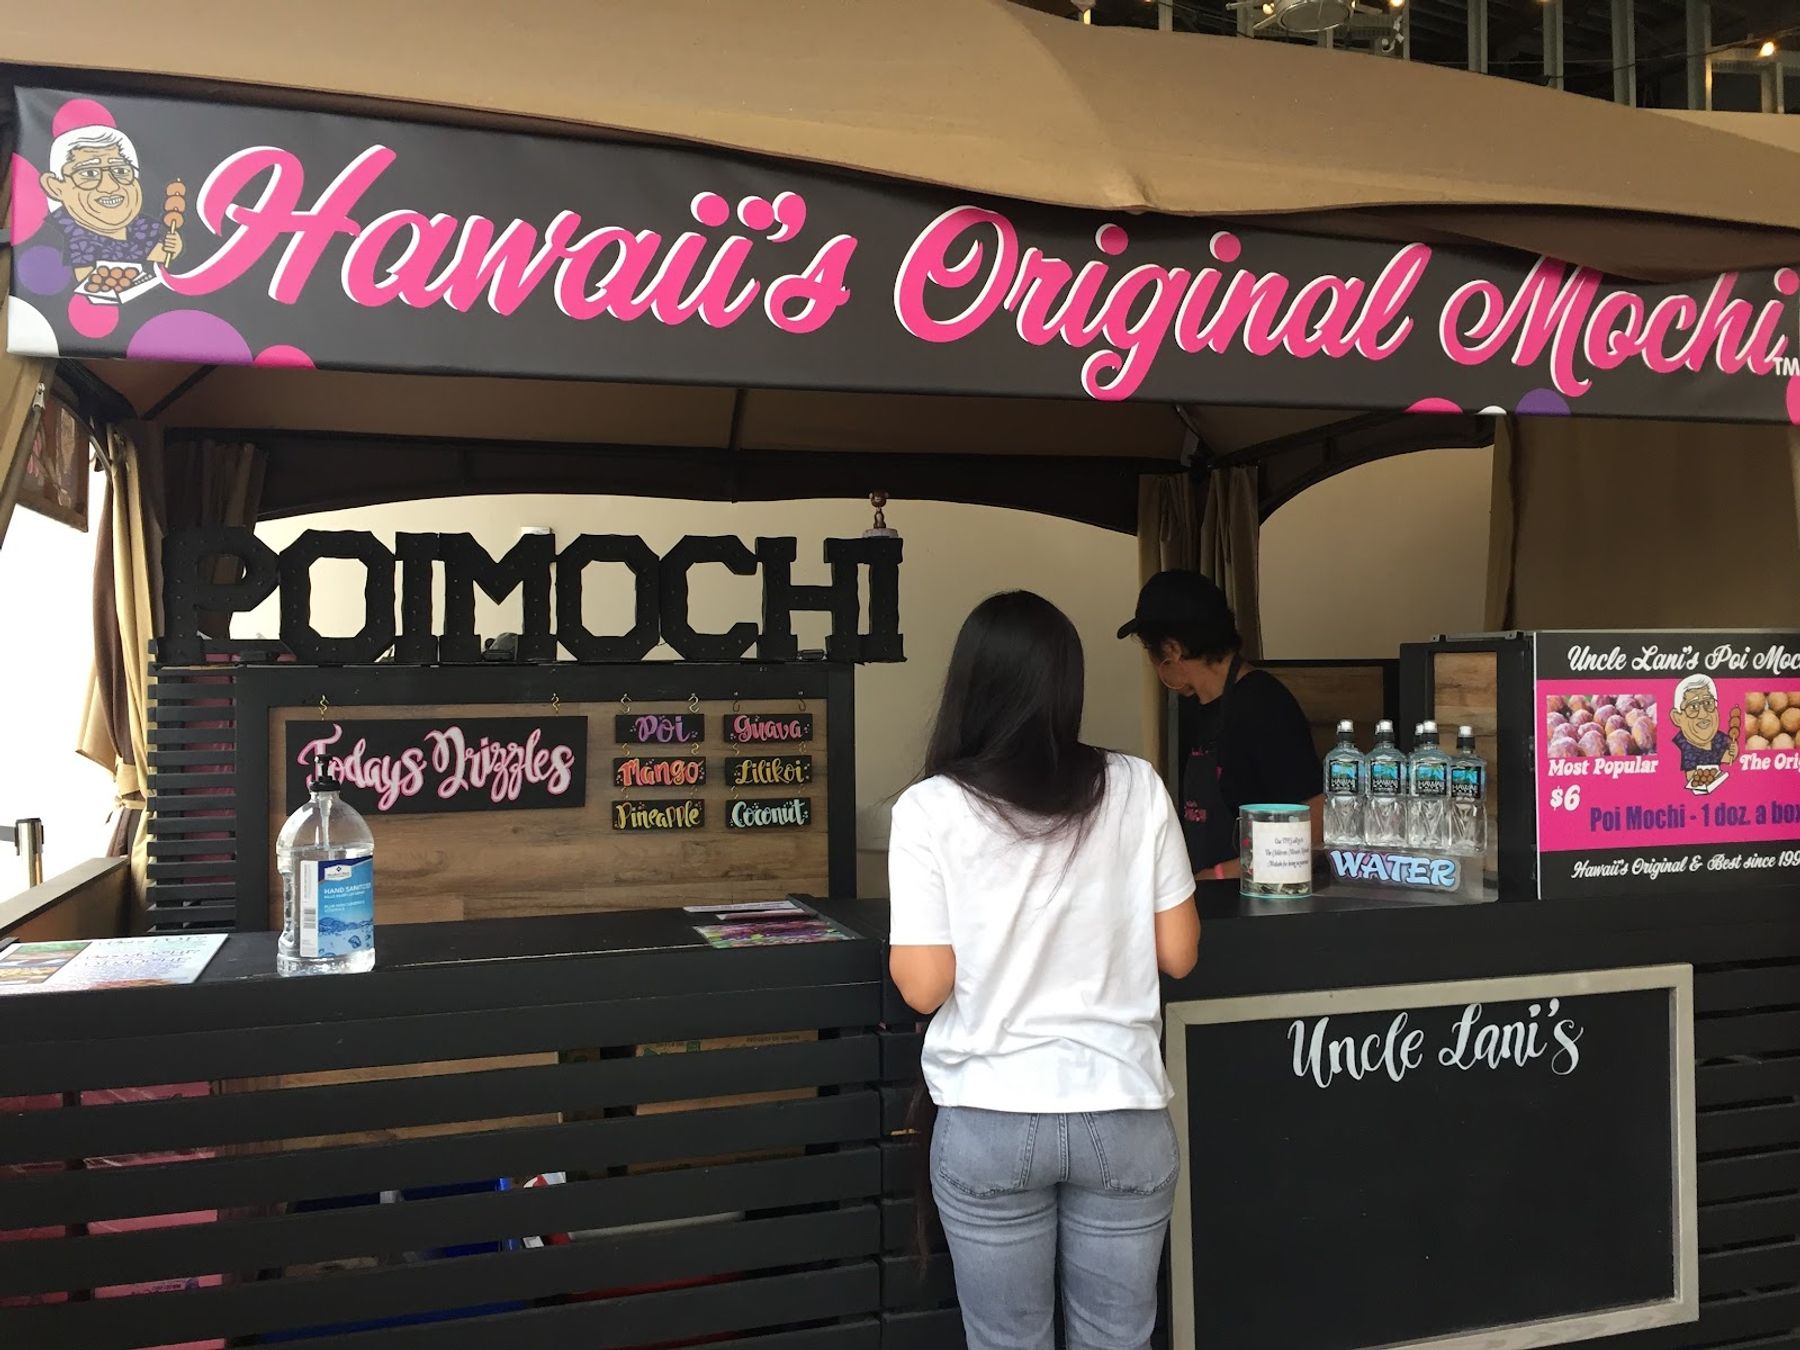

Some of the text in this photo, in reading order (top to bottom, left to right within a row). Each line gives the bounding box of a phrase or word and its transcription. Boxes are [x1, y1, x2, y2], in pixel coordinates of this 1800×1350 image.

[160, 144, 858, 334] Hawaii's
[894, 204, 1432, 402] Original
[1438, 254, 1800, 398] Mochi
[1567, 645, 1627, 671] Uncle
[1632, 645, 1699, 671] Lani's
[1704, 644, 1751, 670] Poi
[634, 715, 690, 743] Poi
[733, 715, 801, 743] Guava
[297, 724, 575, 811] Todays Drizzles
[618, 757, 704, 787] Mango
[735, 757, 805, 785] Lilikoi
[1548, 756, 1659, 779] Most Popular
[1740, 752, 1800, 773] The Ori
[1550, 784, 1580, 811] $6
[616, 802, 700, 829] Pineapple
[732, 799, 805, 828] Coconut
[1590, 806, 1621, 832] Poi
[1626, 804, 1685, 830] Mochi
[1701, 803, 1710, 828] 1
[1715, 801, 1751, 827] doz.
[1755, 804, 1767, 825] a
[1329, 850, 1456, 888] WATER
[1571, 859, 1629, 879] Hawaii's
[1631, 857, 1687, 880] Original
[1689, 856, 1703, 871] &
[1707, 853, 1742, 870] Best
[1743, 853, 1777, 869] since
[324, 886, 345, 895] HAND
[1288, 998, 1584, 1088] Uncle Lani's
